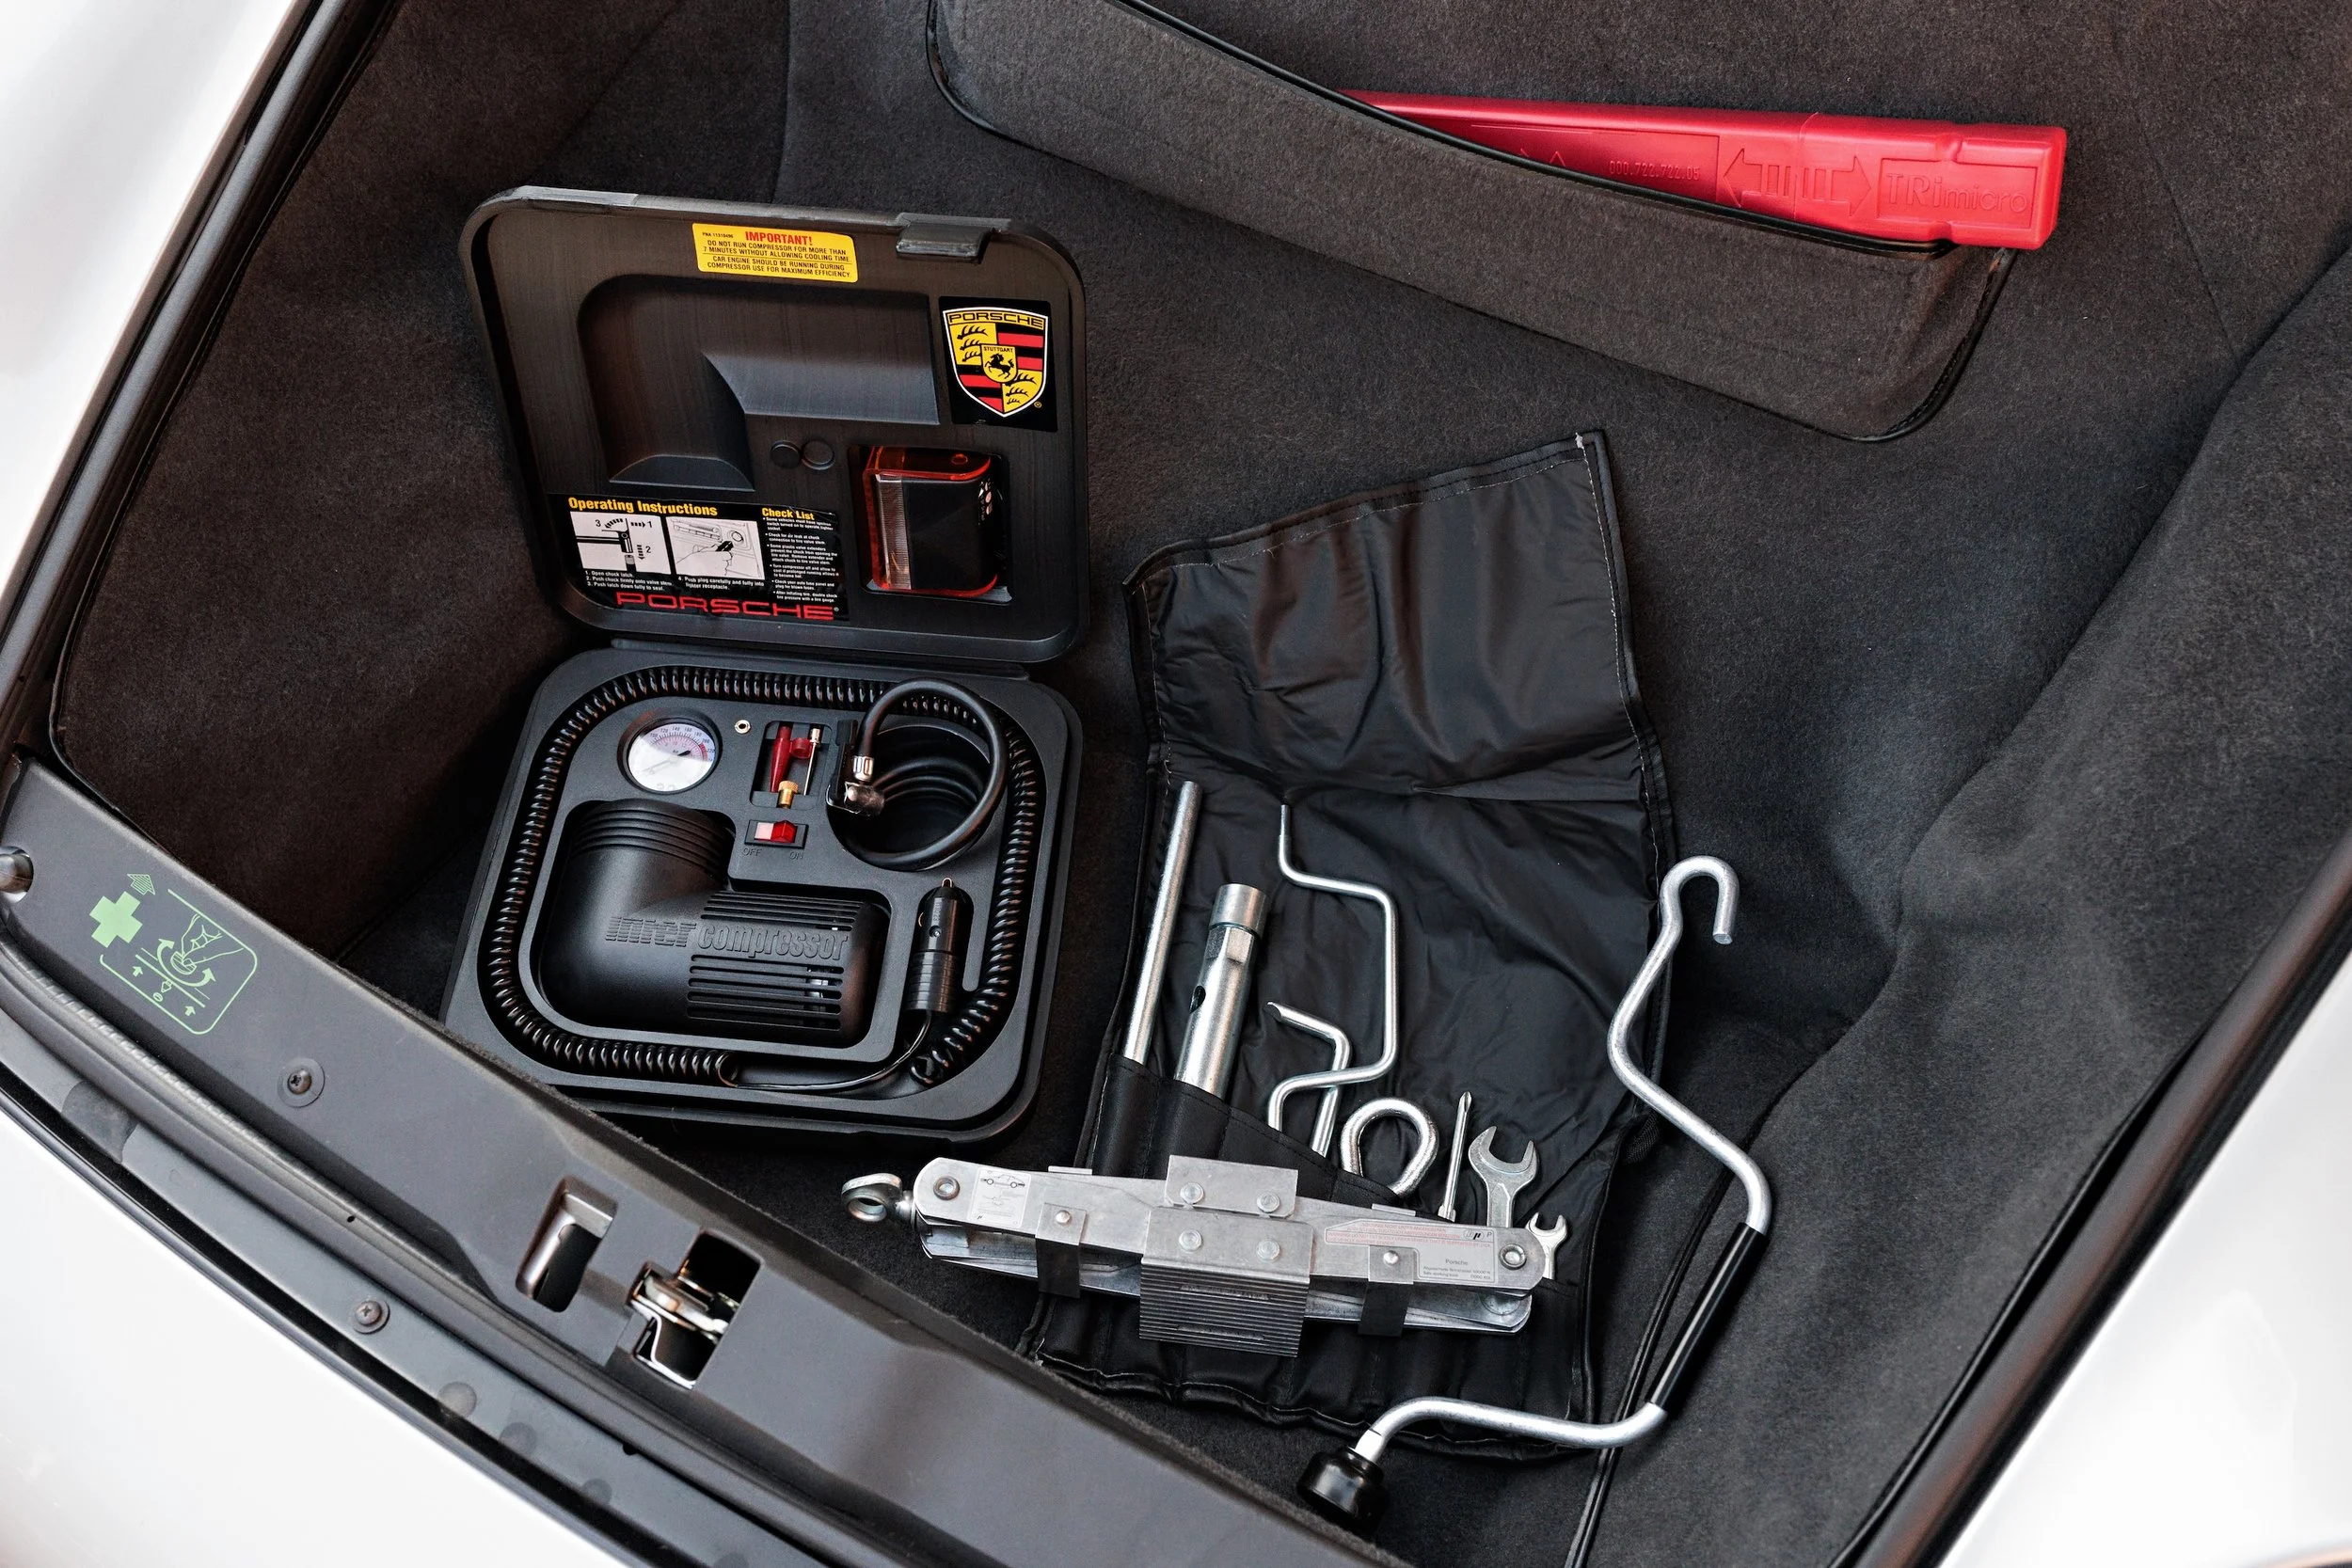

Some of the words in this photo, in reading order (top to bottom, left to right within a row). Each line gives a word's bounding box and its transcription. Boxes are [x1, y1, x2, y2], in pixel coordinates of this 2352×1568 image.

[745, 230, 812, 245] IMPORTANT!
[749, 243, 792, 251] COMPRESSOR
[707, 261, 751, 271] COMPRESSOR
[949, 312, 1042, 328] PORSCHE
[568, 497, 634, 514] Operating
[637, 500, 718, 516] Instructions
[761, 507, 793, 518] Check
[795, 511, 815, 520] List
[596, 519, 601, 528] 3
[616, 592, 834, 620] PORSCHE
[742, 847, 762, 857] OFF
[790, 851, 803, 860] ON
[697, 923, 849, 960] compressor
